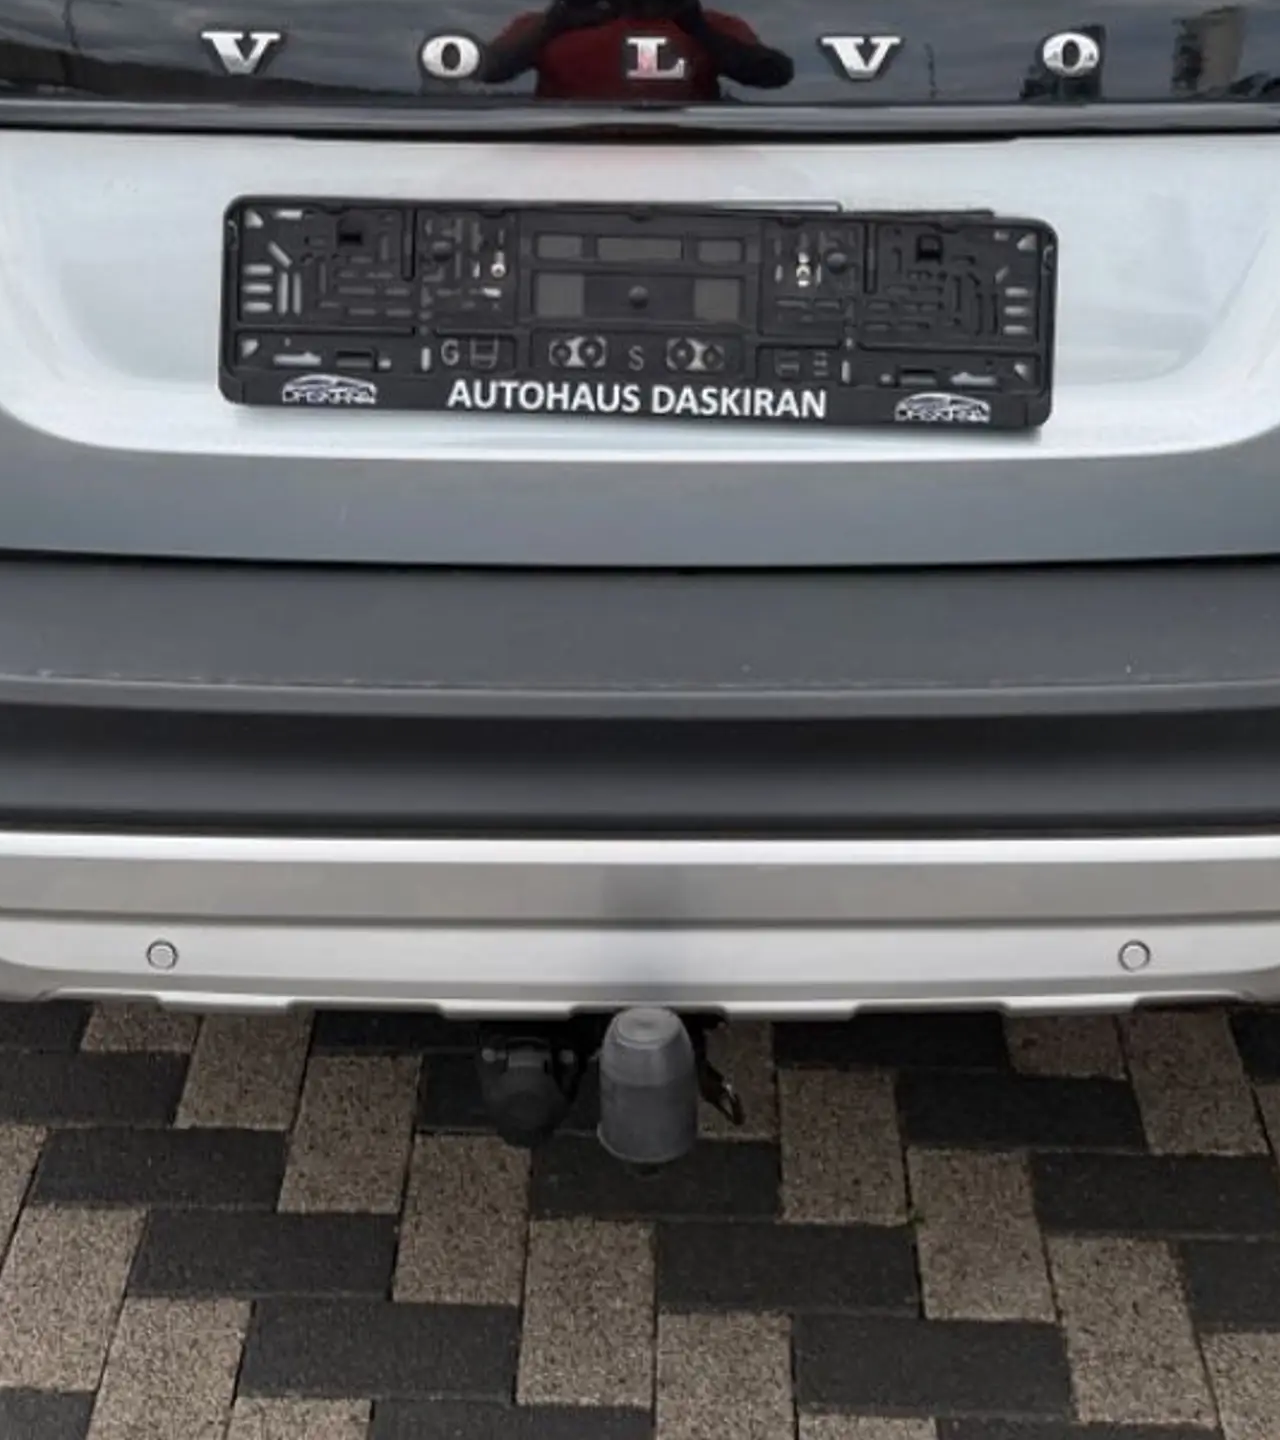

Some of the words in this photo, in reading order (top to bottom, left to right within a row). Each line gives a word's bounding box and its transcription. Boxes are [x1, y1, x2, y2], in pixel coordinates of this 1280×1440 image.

[203, 29, 1101, 82] VOLVO
[447, 379, 641, 413] AUTOHAUS
[651, 385, 827, 419] DASKIRAN
